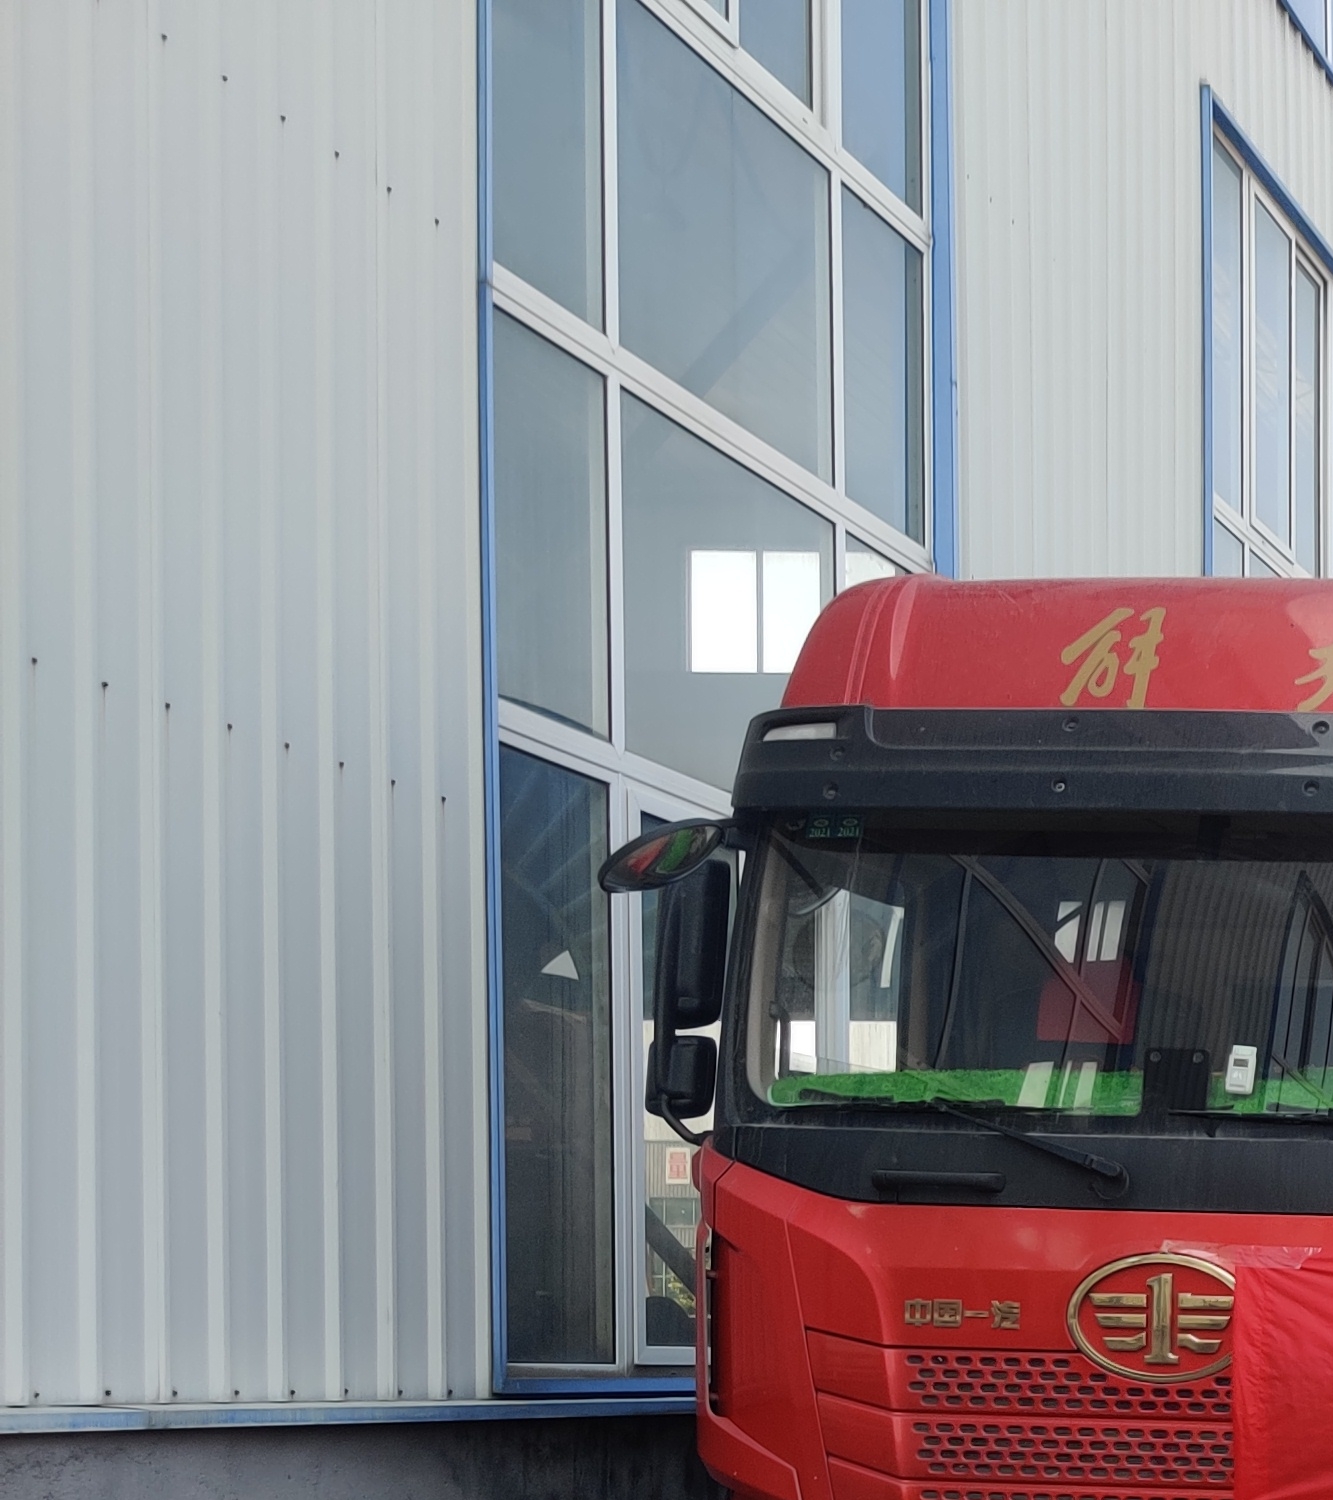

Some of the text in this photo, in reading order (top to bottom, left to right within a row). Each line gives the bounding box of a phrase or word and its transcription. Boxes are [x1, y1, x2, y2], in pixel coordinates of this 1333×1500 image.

[809, 827, 830, 838] 2021
[837, 826, 859, 837] 2021
[904, 1298, 1020, 1330] 中国一汽
